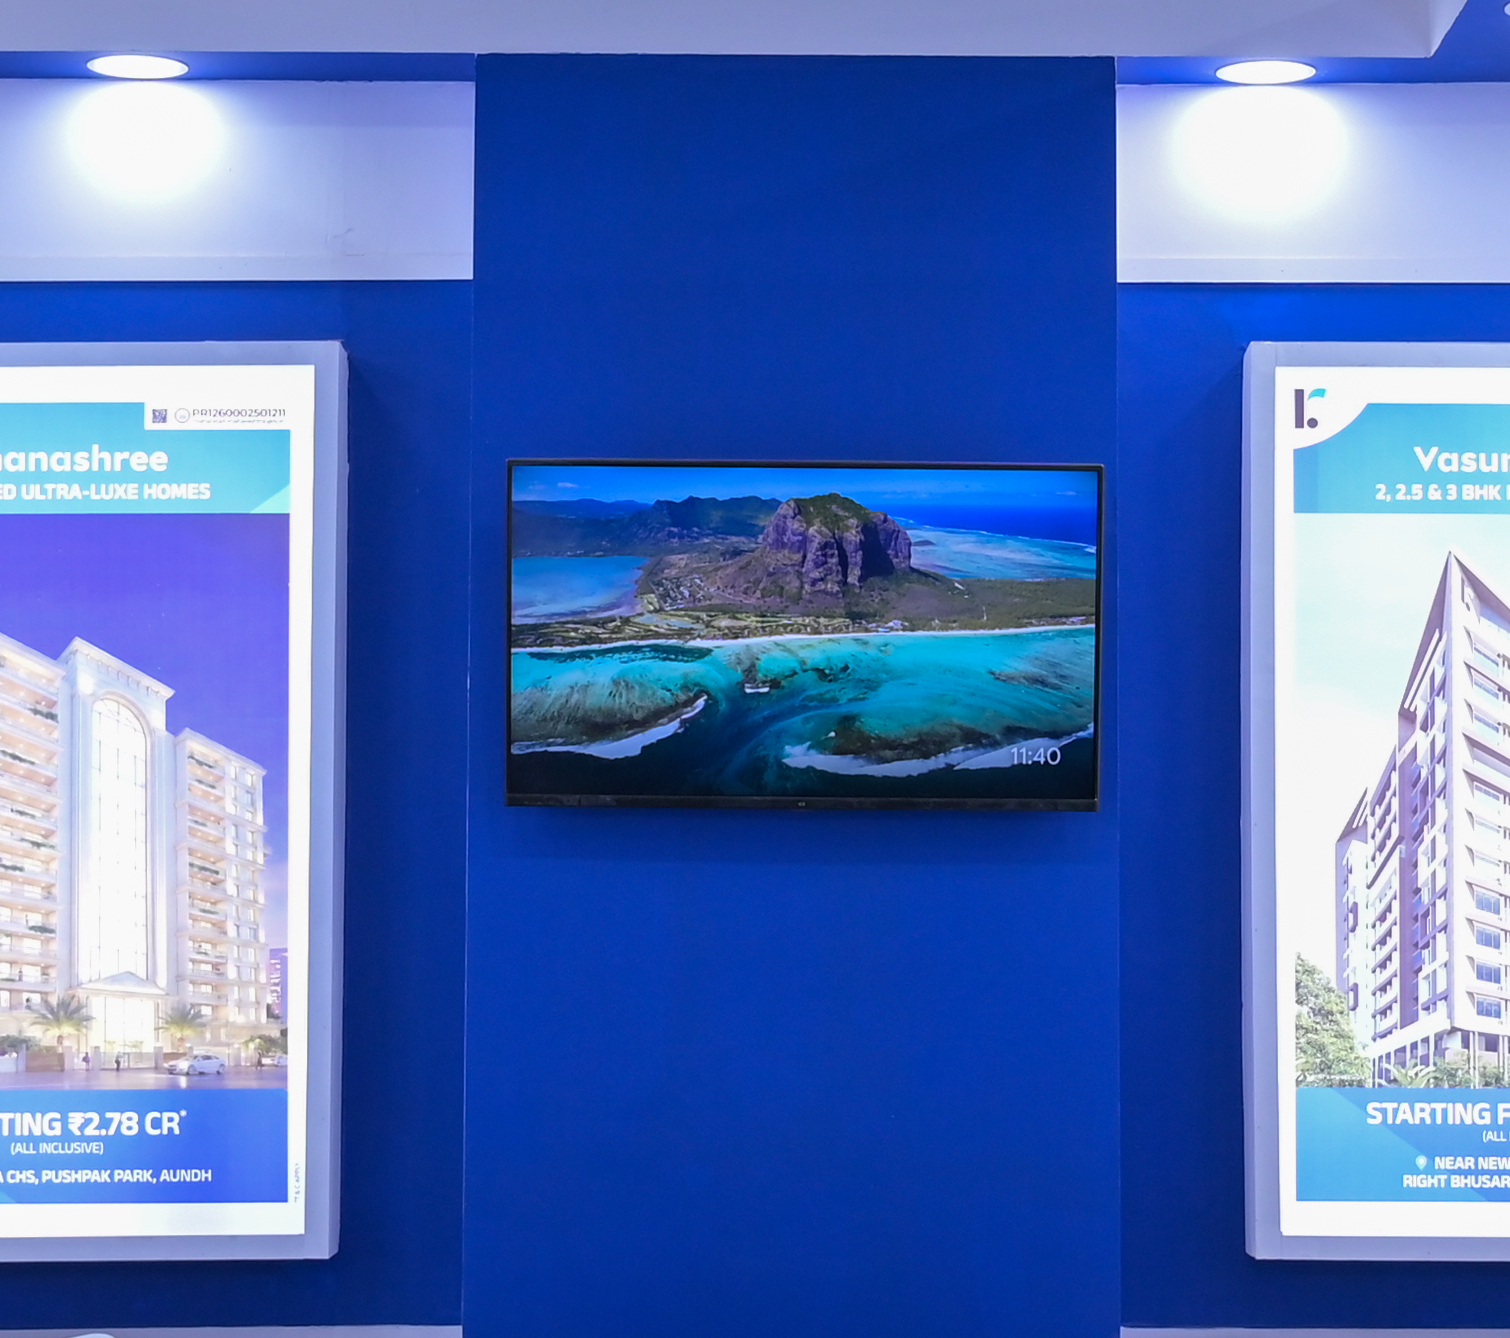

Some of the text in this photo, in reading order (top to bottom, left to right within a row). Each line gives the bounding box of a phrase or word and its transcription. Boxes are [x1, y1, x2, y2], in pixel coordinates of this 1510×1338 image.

[21, 482, 139, 501] ULTRA-LUXE
[143, 482, 211, 501] HOMES
[1374, 483, 1391, 503] 2,
[1395, 483, 1423, 501] 2.5
[1427, 483, 1443, 501] &
[1445, 484, 1458, 501] 3
[1461, 484, 1502, 501] BHK
[1010, 746, 1061, 767] 11:40
[1365, 1101, 1491, 1125] STARTING
[68, 1111, 140, 1136] ₹2.78
[1482, 1130, 1507, 1144] (ALL
[10, 1141, 104, 1156] (ALL INCLUSIVE)
[1434, 1156, 1475, 1171] NEAR
[6, 1169, 40, 1185] CHS,
[42, 1169, 112, 1184] PUSHPAK
[114, 1169, 157, 1184] PARK,
[159, 1169, 212, 1183] AUNDH
[1402, 1174, 1448, 1189] RIGHT
